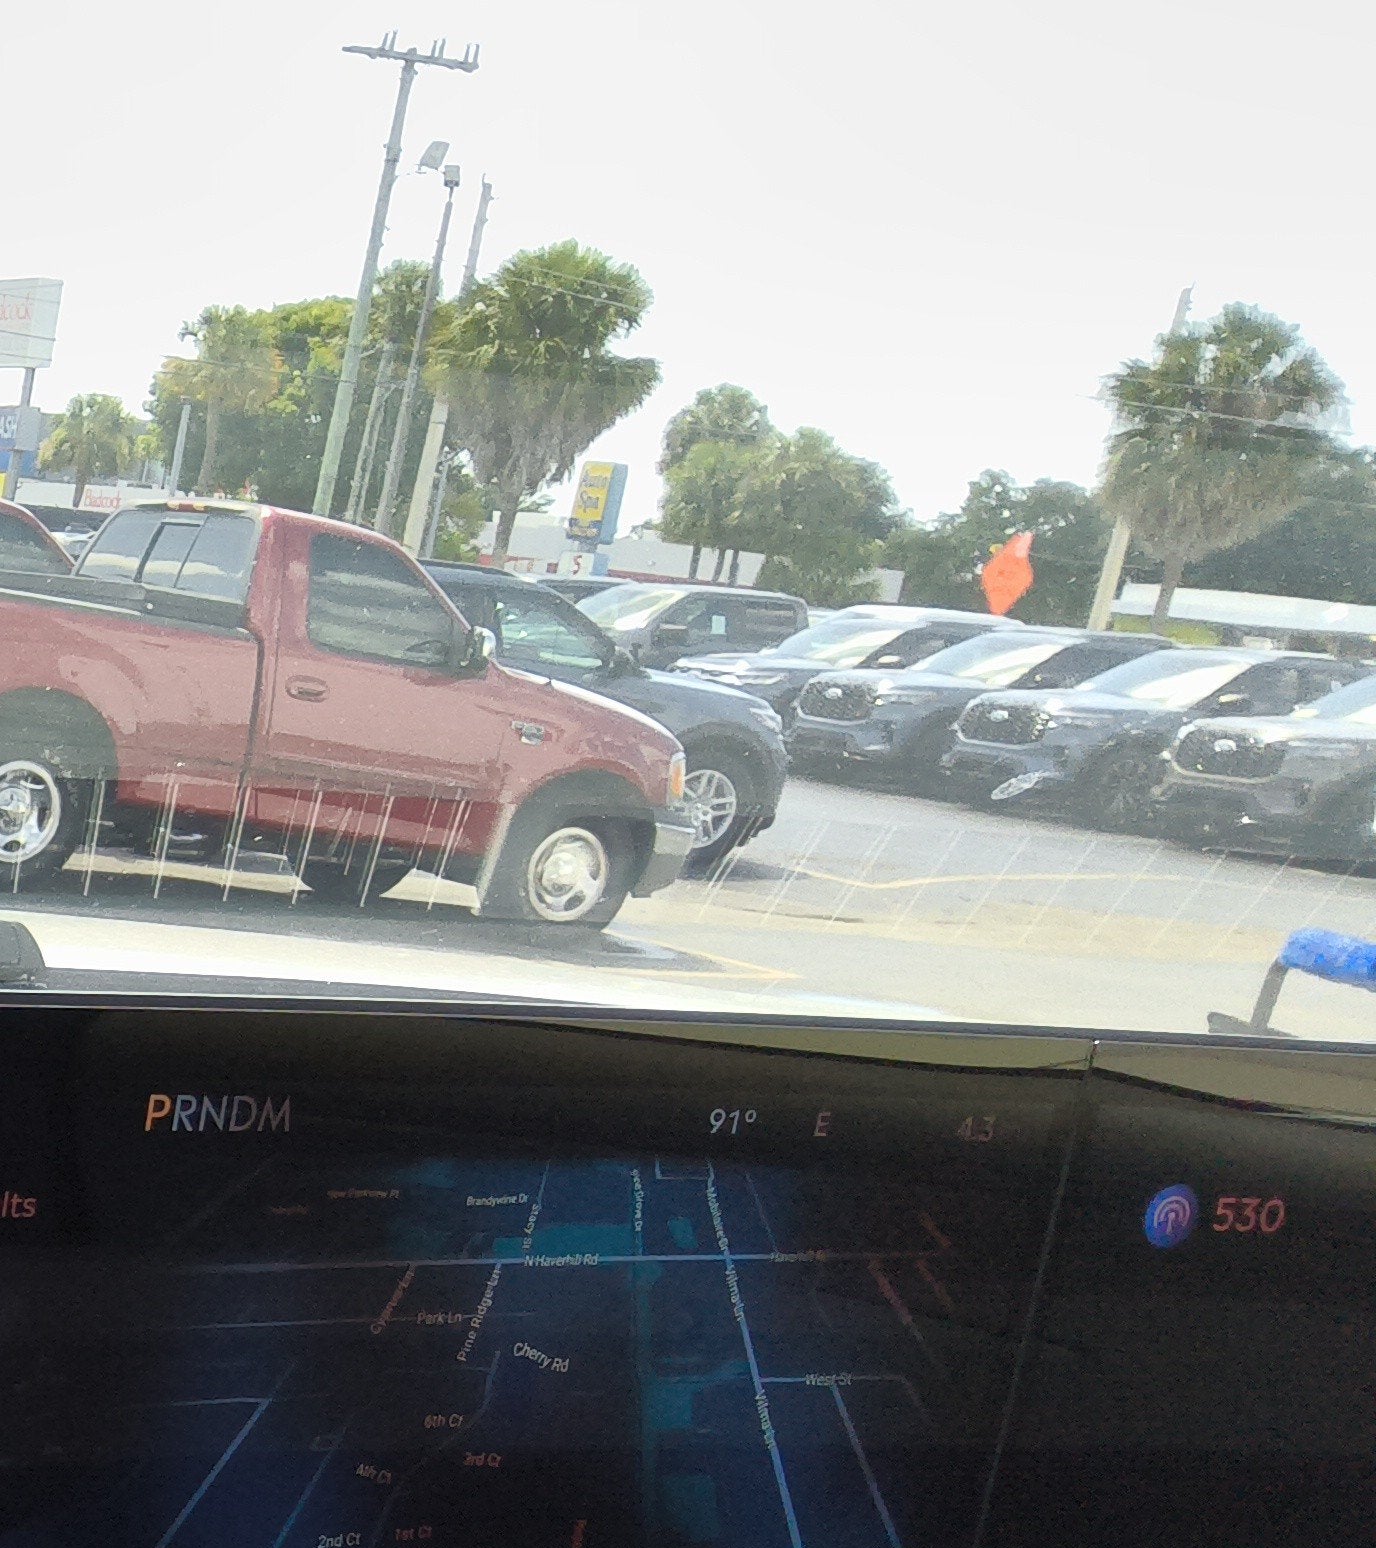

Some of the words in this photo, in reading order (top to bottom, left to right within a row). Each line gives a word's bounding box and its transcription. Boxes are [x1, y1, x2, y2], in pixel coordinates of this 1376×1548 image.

[813, 1111, 832, 1138] E
[1211, 1195, 1286, 1235] 530
[456, 1327, 477, 1362] Pine
[470, 1290, 493, 1329] Ridge
[513, 1342, 552, 1369] Cherry
[550, 1357, 569, 1372] Rd
[317, 1534, 343, 1548] 2nd
[345, 1533, 362, 1547] Ct
